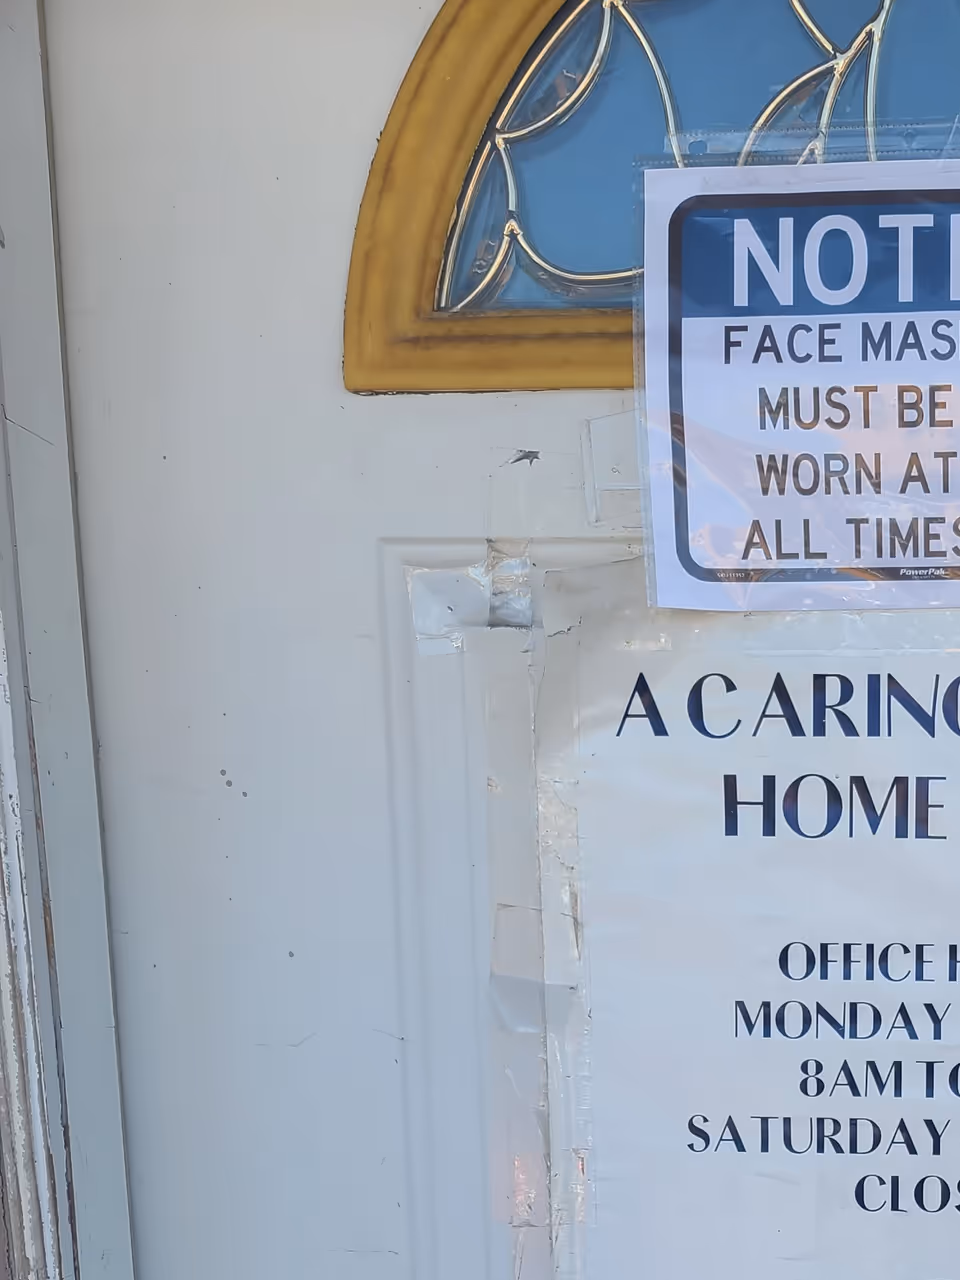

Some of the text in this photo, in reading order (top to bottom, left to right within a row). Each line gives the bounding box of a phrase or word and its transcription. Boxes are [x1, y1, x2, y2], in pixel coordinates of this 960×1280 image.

[722, 322, 842, 365] FACE
[758, 384, 954, 431] MUST BE
[756, 450, 958, 497] WORN AT
[741, 517, 827, 561] ALL
[900, 568, 944, 576] PowerPak
[616, 672, 669, 737] A
[723, 773, 948, 840] HOME
[778, 941, 934, 982] OFFICE
[734, 1000, 952, 1040] MONDAY
[799, 1058, 902, 1098] 8AM
[686, 1114, 952, 1156] SATURDAY
